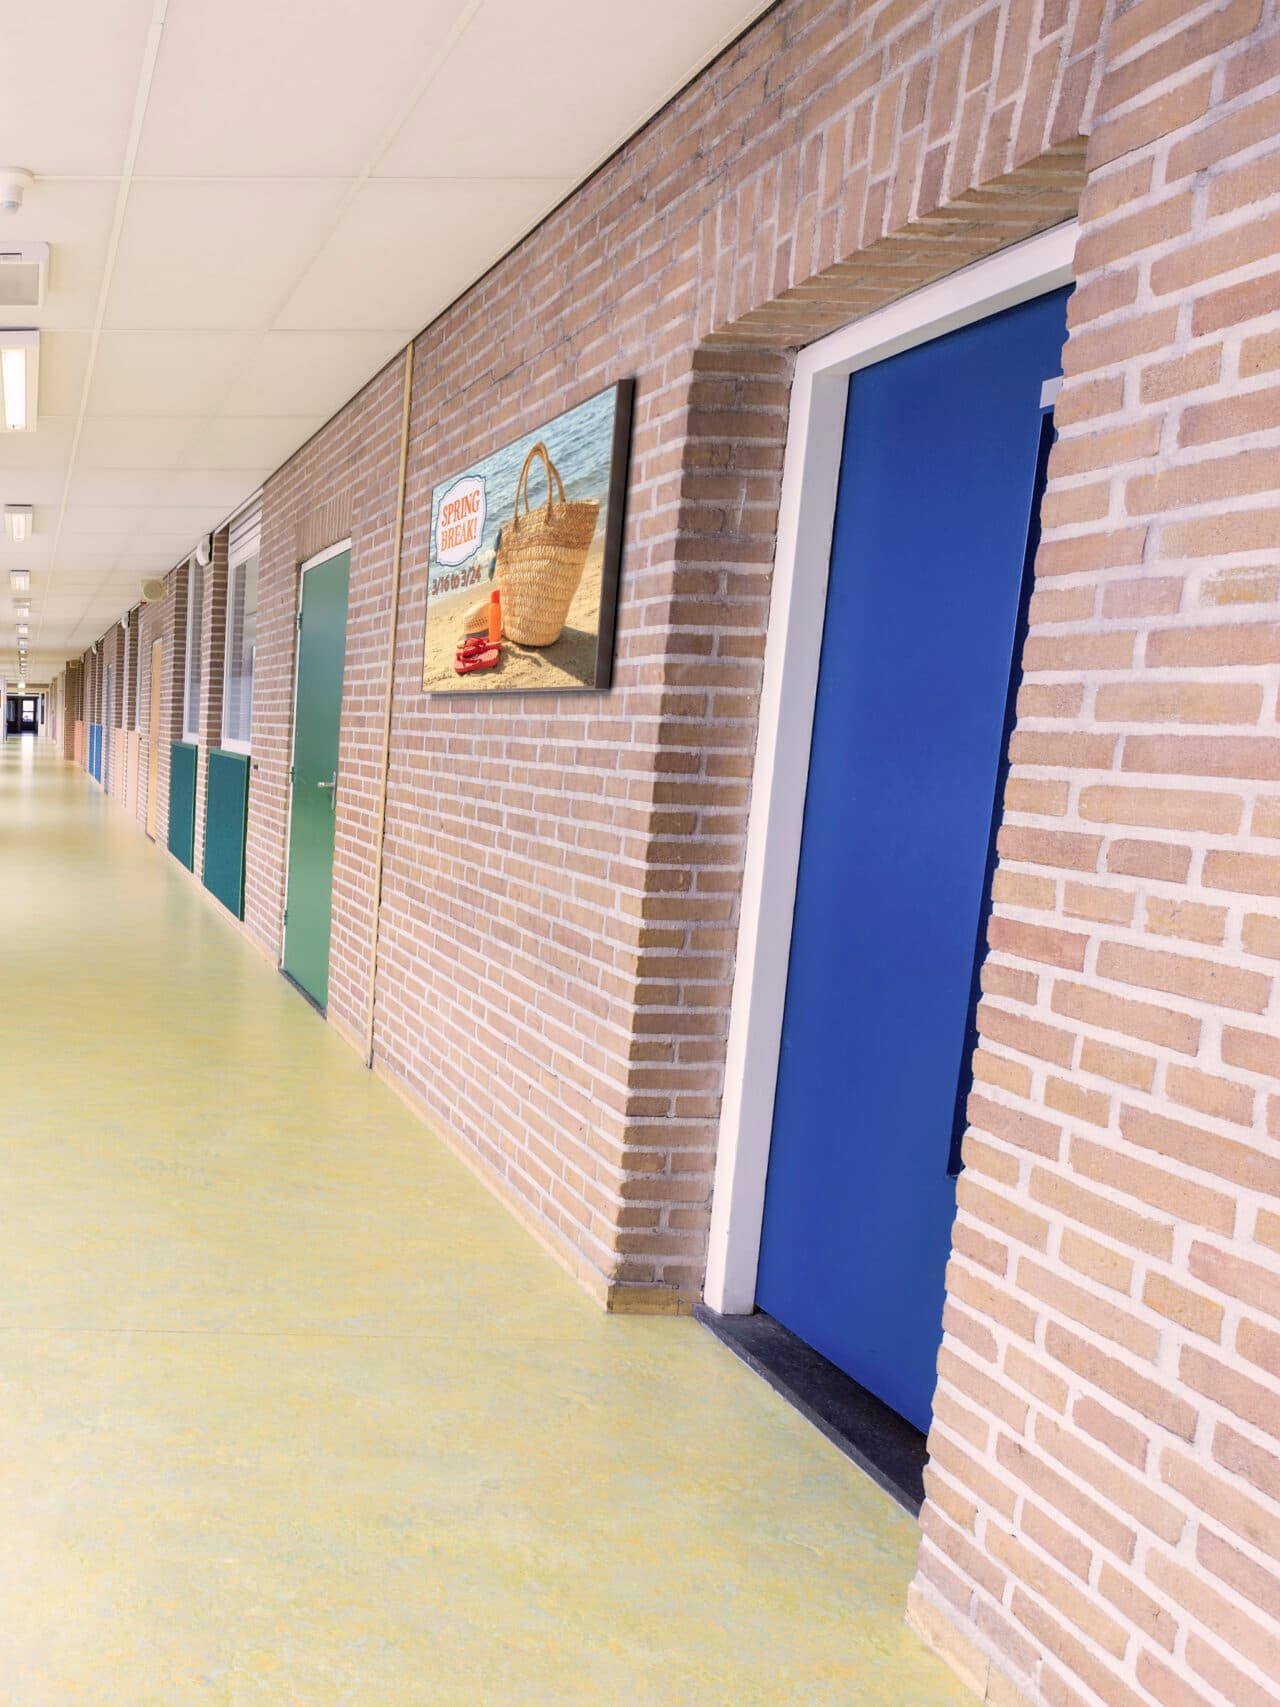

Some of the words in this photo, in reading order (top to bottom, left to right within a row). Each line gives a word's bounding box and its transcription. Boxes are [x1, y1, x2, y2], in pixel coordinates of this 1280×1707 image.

[441, 489, 480, 527] SPRING
[441, 516, 477, 552] BREAK!
[432, 575, 450, 596] 3/16
[450, 575, 460, 590] to
[461, 565, 481, 588] 3/24
